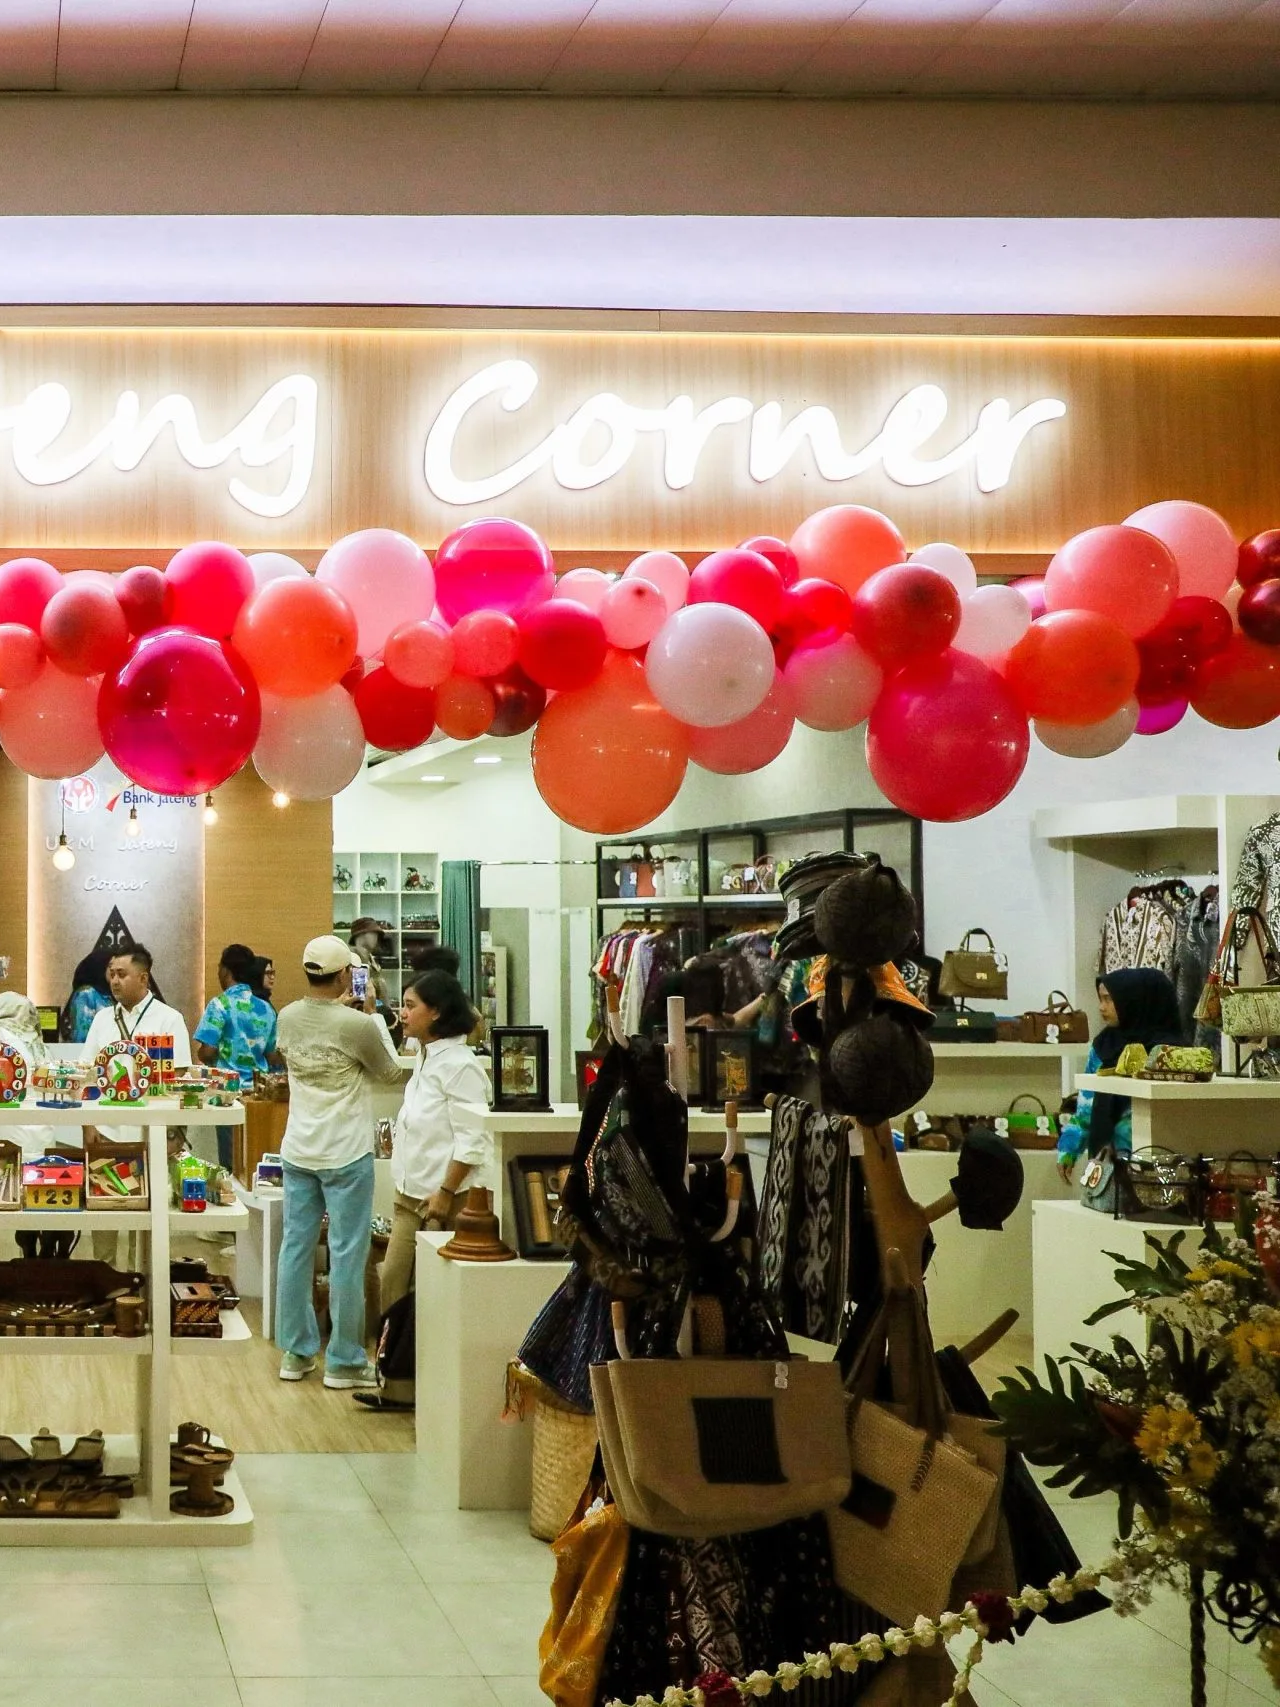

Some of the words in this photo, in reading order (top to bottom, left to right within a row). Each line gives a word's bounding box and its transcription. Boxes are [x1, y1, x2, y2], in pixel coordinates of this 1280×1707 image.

[423, 360, 1067, 505] Corner
[123, 791, 155, 804] Bank
[118, 836, 178, 854] Jateng
[84, 875, 149, 891] Corner
